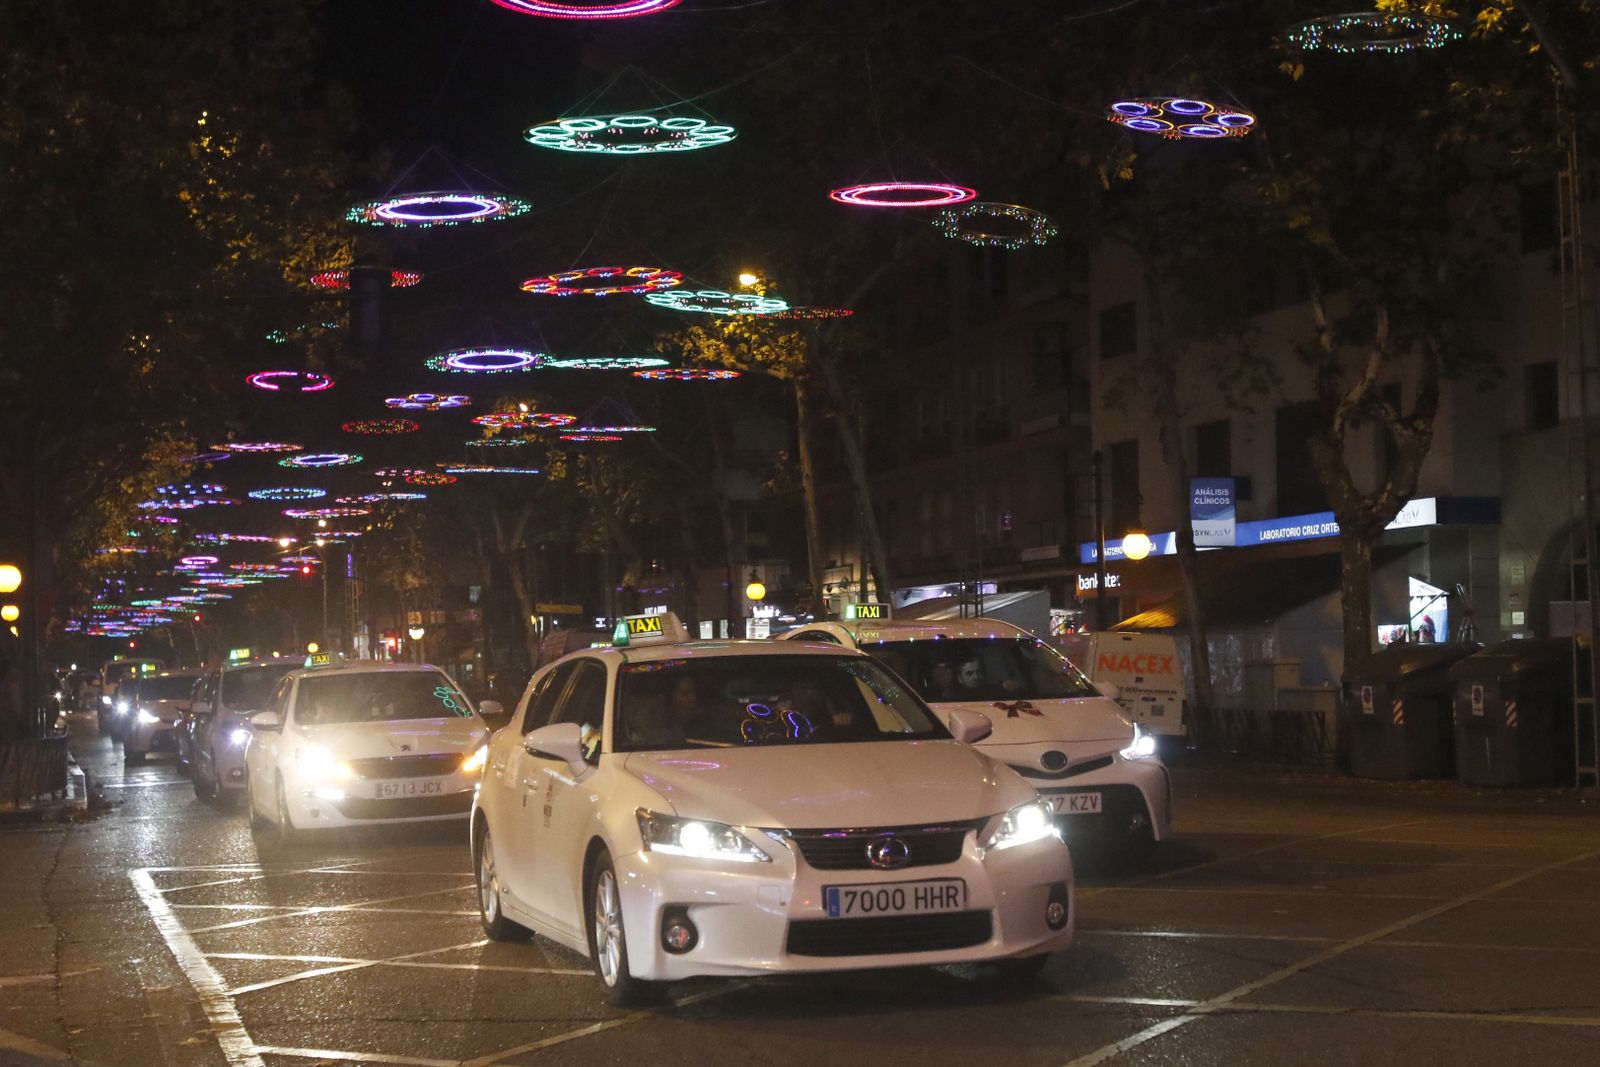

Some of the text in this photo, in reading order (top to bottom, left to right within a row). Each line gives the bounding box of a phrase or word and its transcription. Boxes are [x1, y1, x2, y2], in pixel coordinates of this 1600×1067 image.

[1195, 488, 1229, 496] ANÁLISIS
[1194, 496, 1230, 505] CLÍNICOS
[1260, 526, 1301, 540] LABORATORIO
[1302, 524, 1320, 536] CRUZ
[857, 606, 880, 618] TAXI
[627, 616, 661, 633] TAXI
[312, 654, 330, 664] TAXI
[1097, 653, 1173, 674] NACEX
[384, 782, 442, 796] 6713 JCX
[1070, 795, 1098, 811] KZV
[844, 886, 959, 914] 7000 HHR
